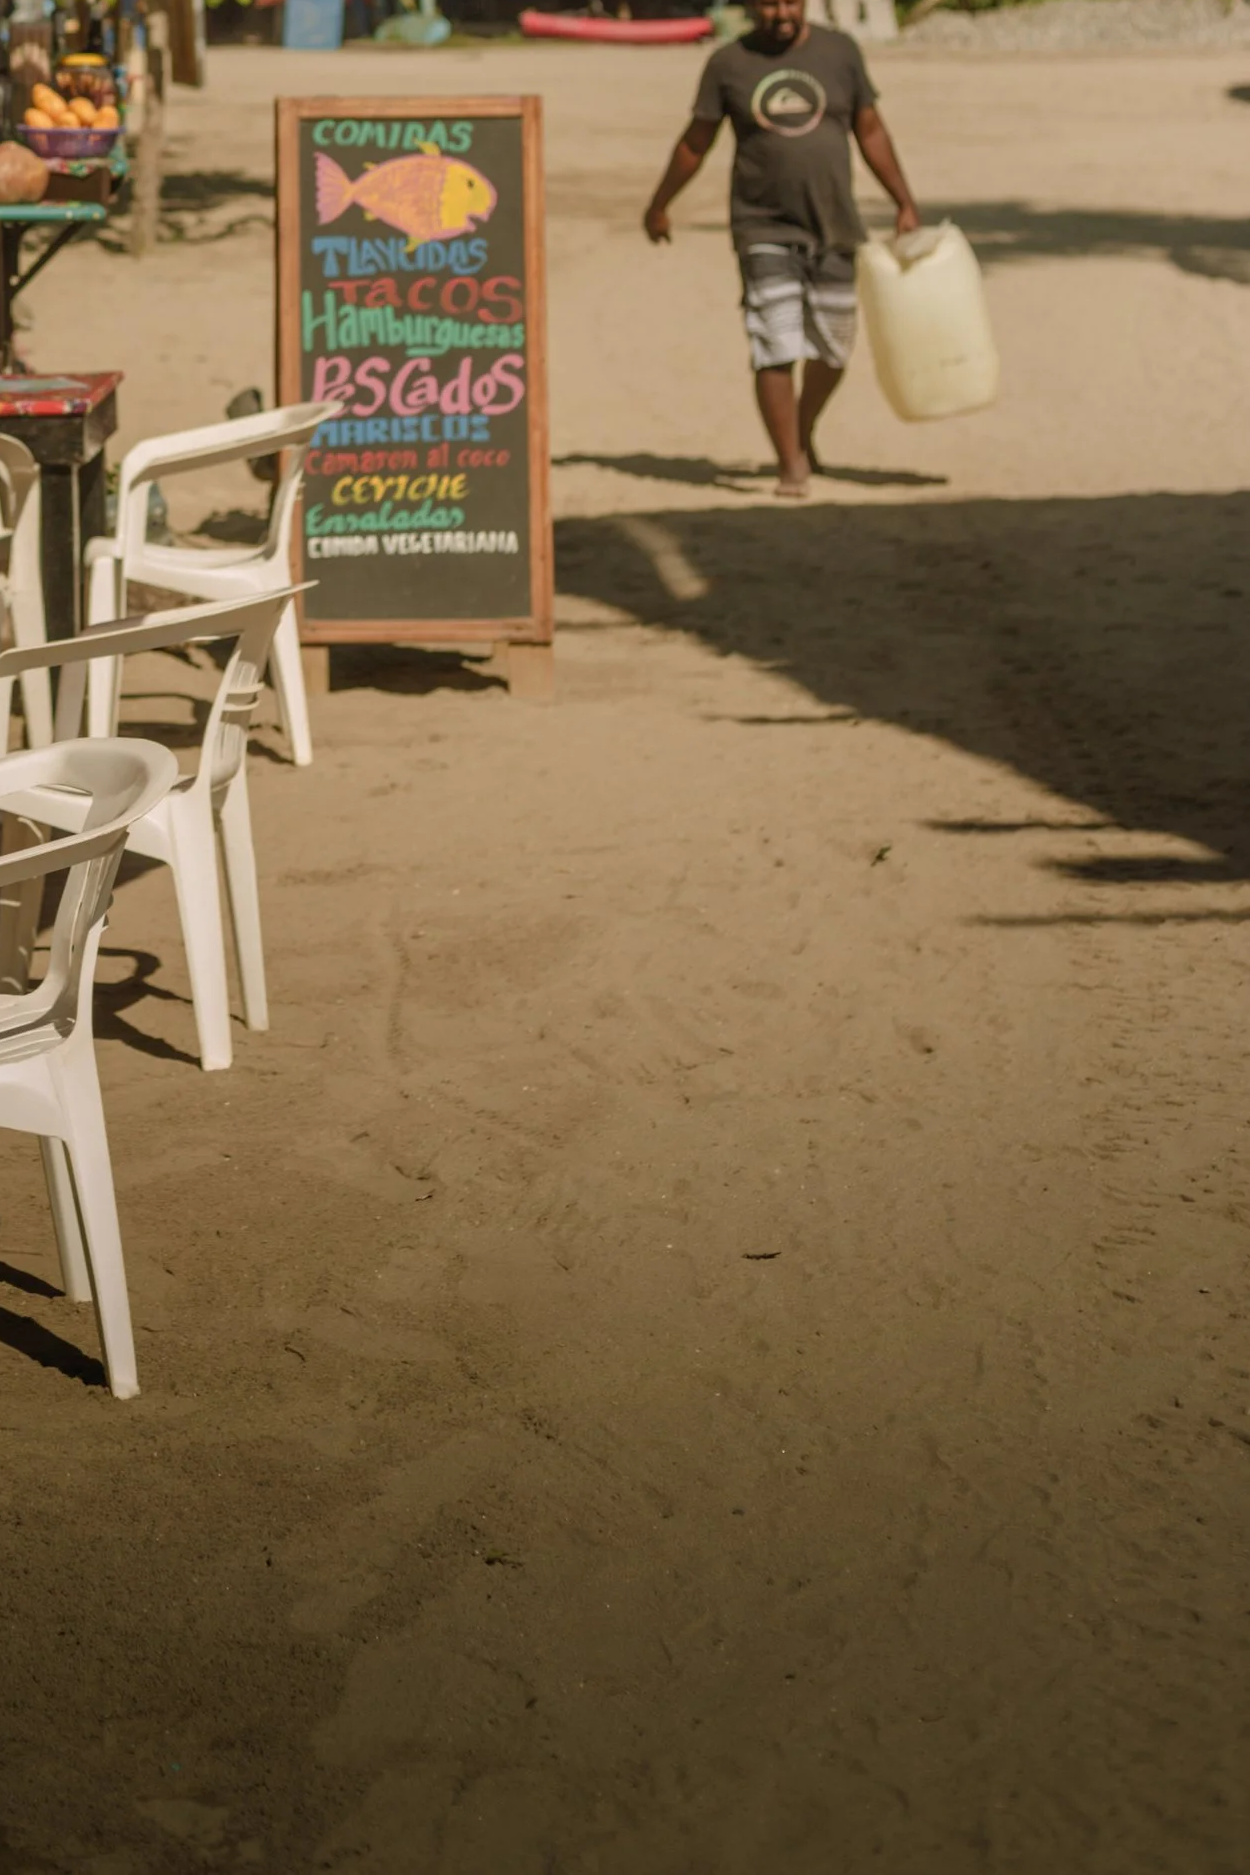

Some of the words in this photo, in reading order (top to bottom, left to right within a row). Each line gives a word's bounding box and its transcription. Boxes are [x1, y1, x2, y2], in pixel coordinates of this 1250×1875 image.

[311, 120, 473, 153] COMIDAS
[302, 289, 524, 356] Hamburguesas
[309, 413, 490, 449] MARISCOS
[426, 441, 450, 470] al
[456, 447, 511, 468] coco
[305, 496, 466, 537] Ensaladas
